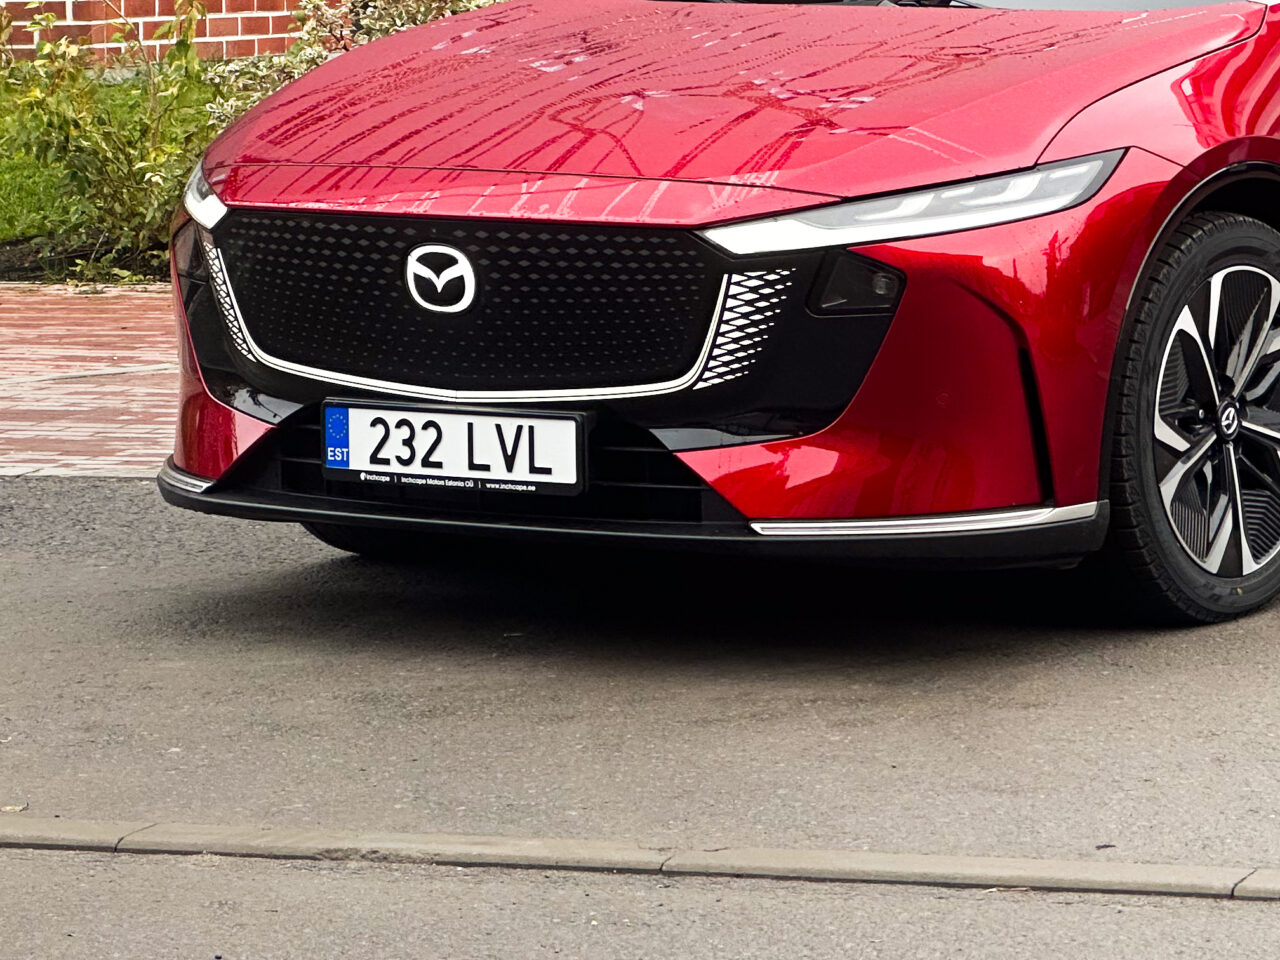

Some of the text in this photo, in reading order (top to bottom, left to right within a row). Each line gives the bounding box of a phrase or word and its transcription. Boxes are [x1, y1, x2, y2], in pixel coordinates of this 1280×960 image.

[327, 447, 349, 461] EST
[369, 416, 552, 475] 232 LVL
